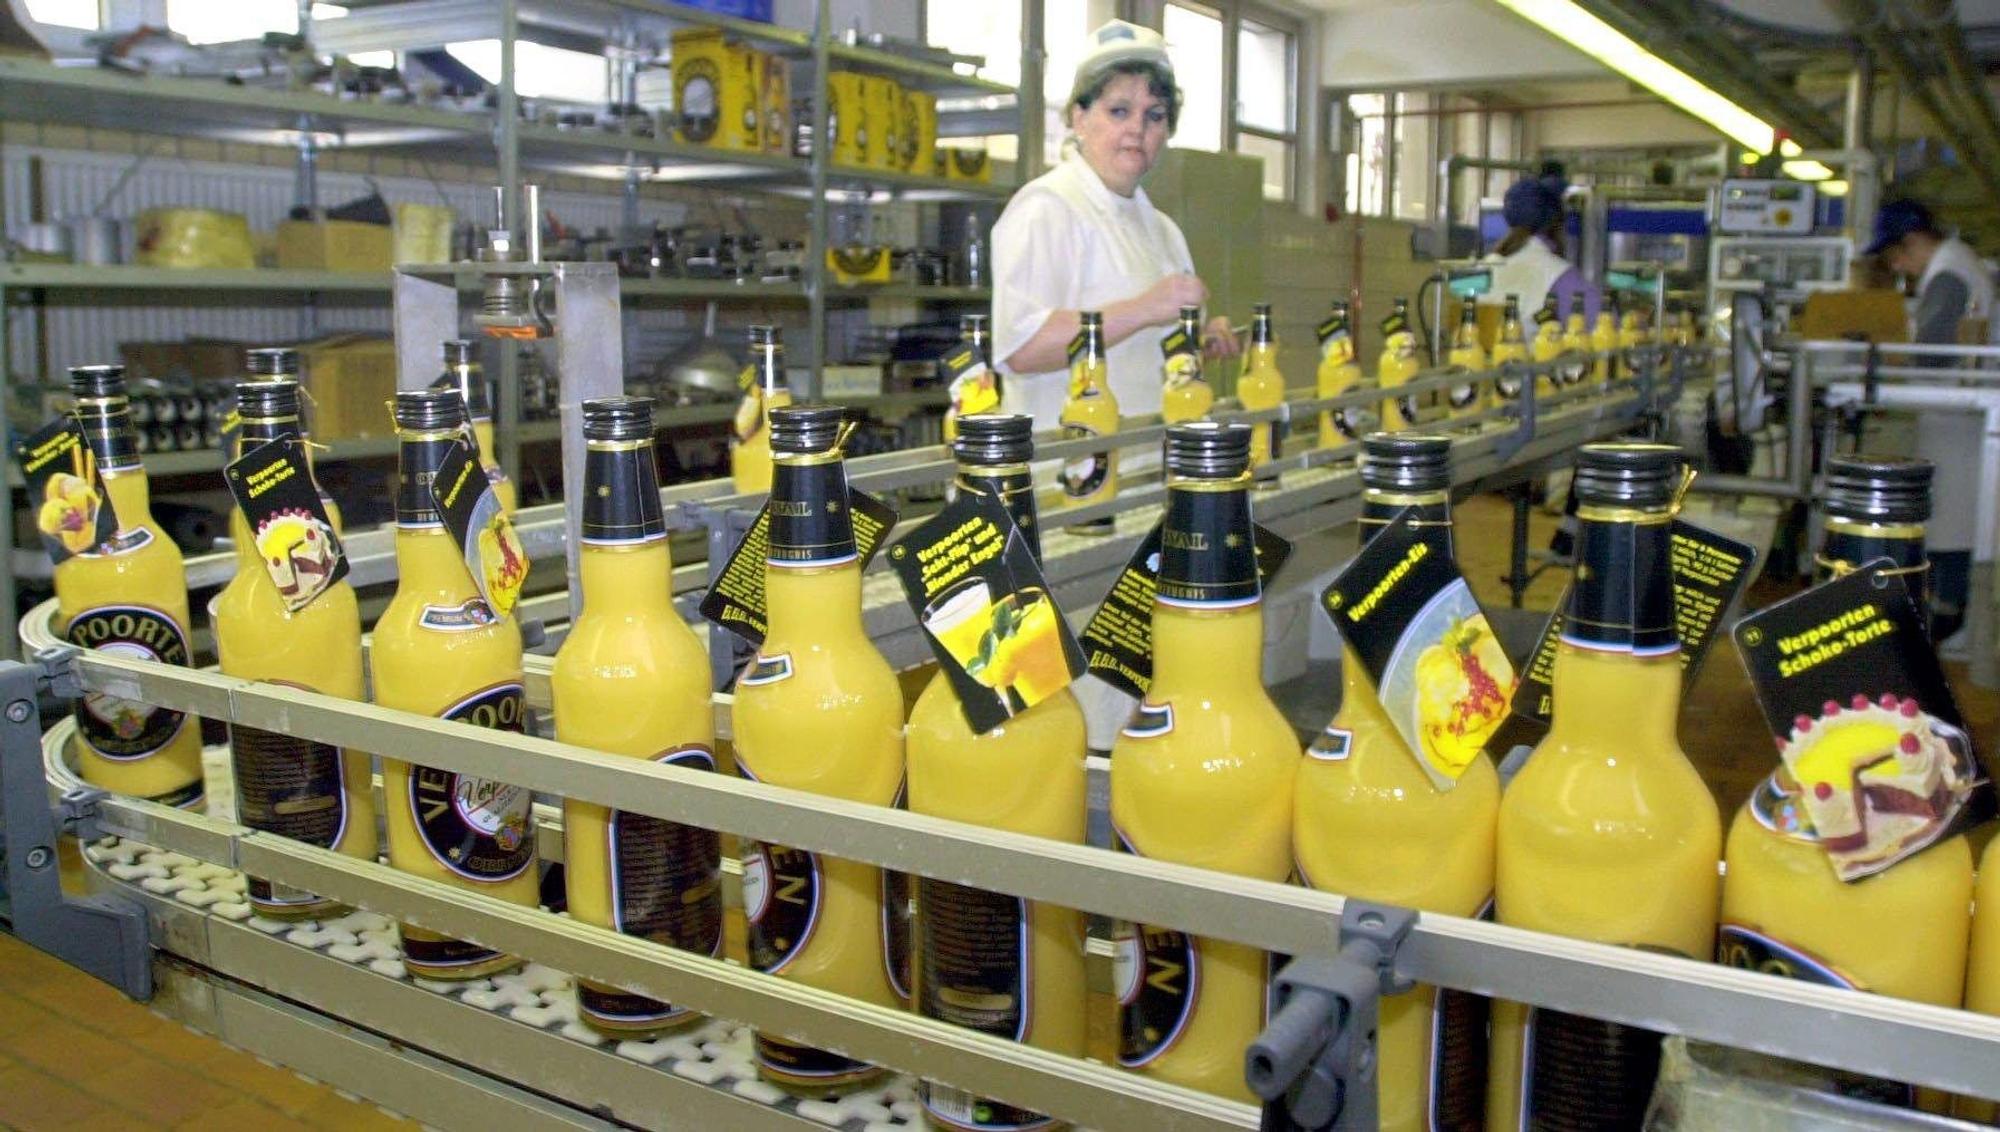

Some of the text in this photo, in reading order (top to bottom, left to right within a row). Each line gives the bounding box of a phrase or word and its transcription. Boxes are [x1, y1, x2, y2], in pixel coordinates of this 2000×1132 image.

[917, 516, 982, 563] Verpoorten
[1777, 603, 1876, 655] Verpoorten
[1777, 619, 1893, 678] Schoko-Torte
